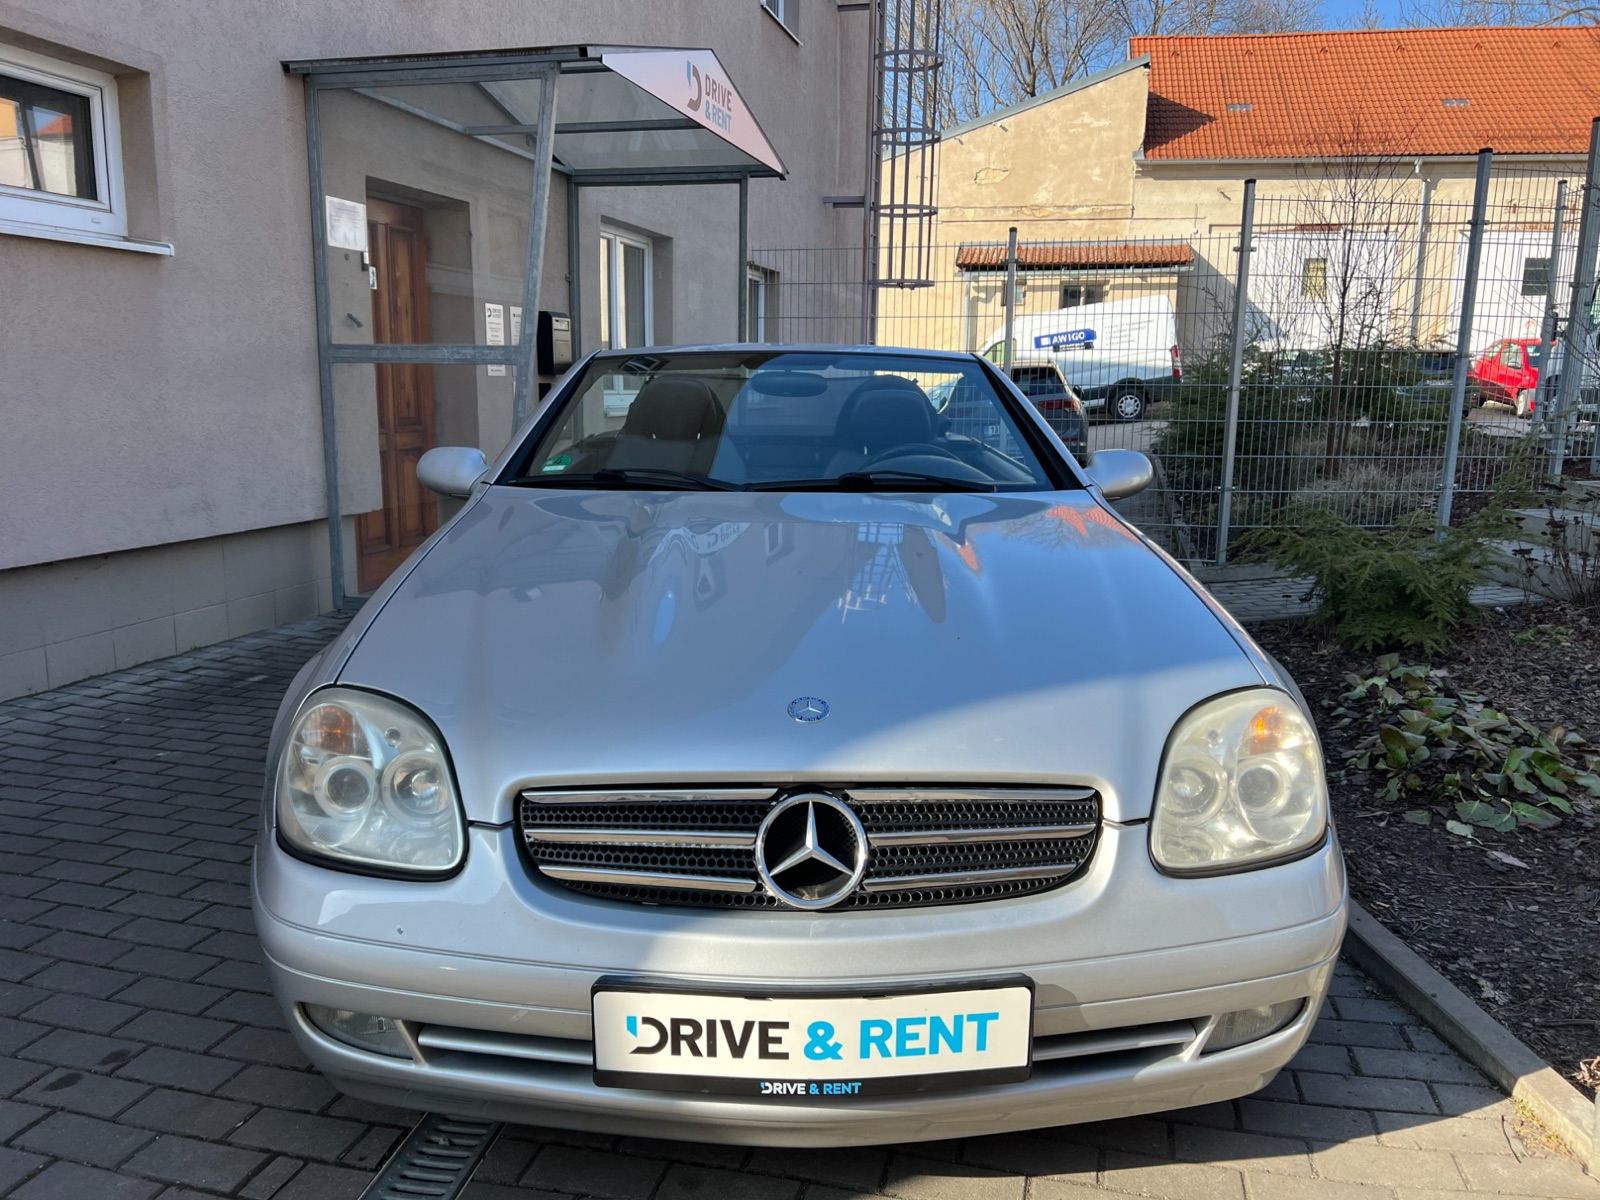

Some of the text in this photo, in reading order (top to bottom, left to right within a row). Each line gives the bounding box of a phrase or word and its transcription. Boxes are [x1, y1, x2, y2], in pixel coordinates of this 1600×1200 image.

[705, 73, 732, 112] DRIVE
[705, 99, 732, 134] & RENT
[1052, 331, 1086, 344] AWIGO
[626, 1012, 999, 1061] DRIVE & RENT
[760, 1082, 861, 1095] DRIVE & RENT
